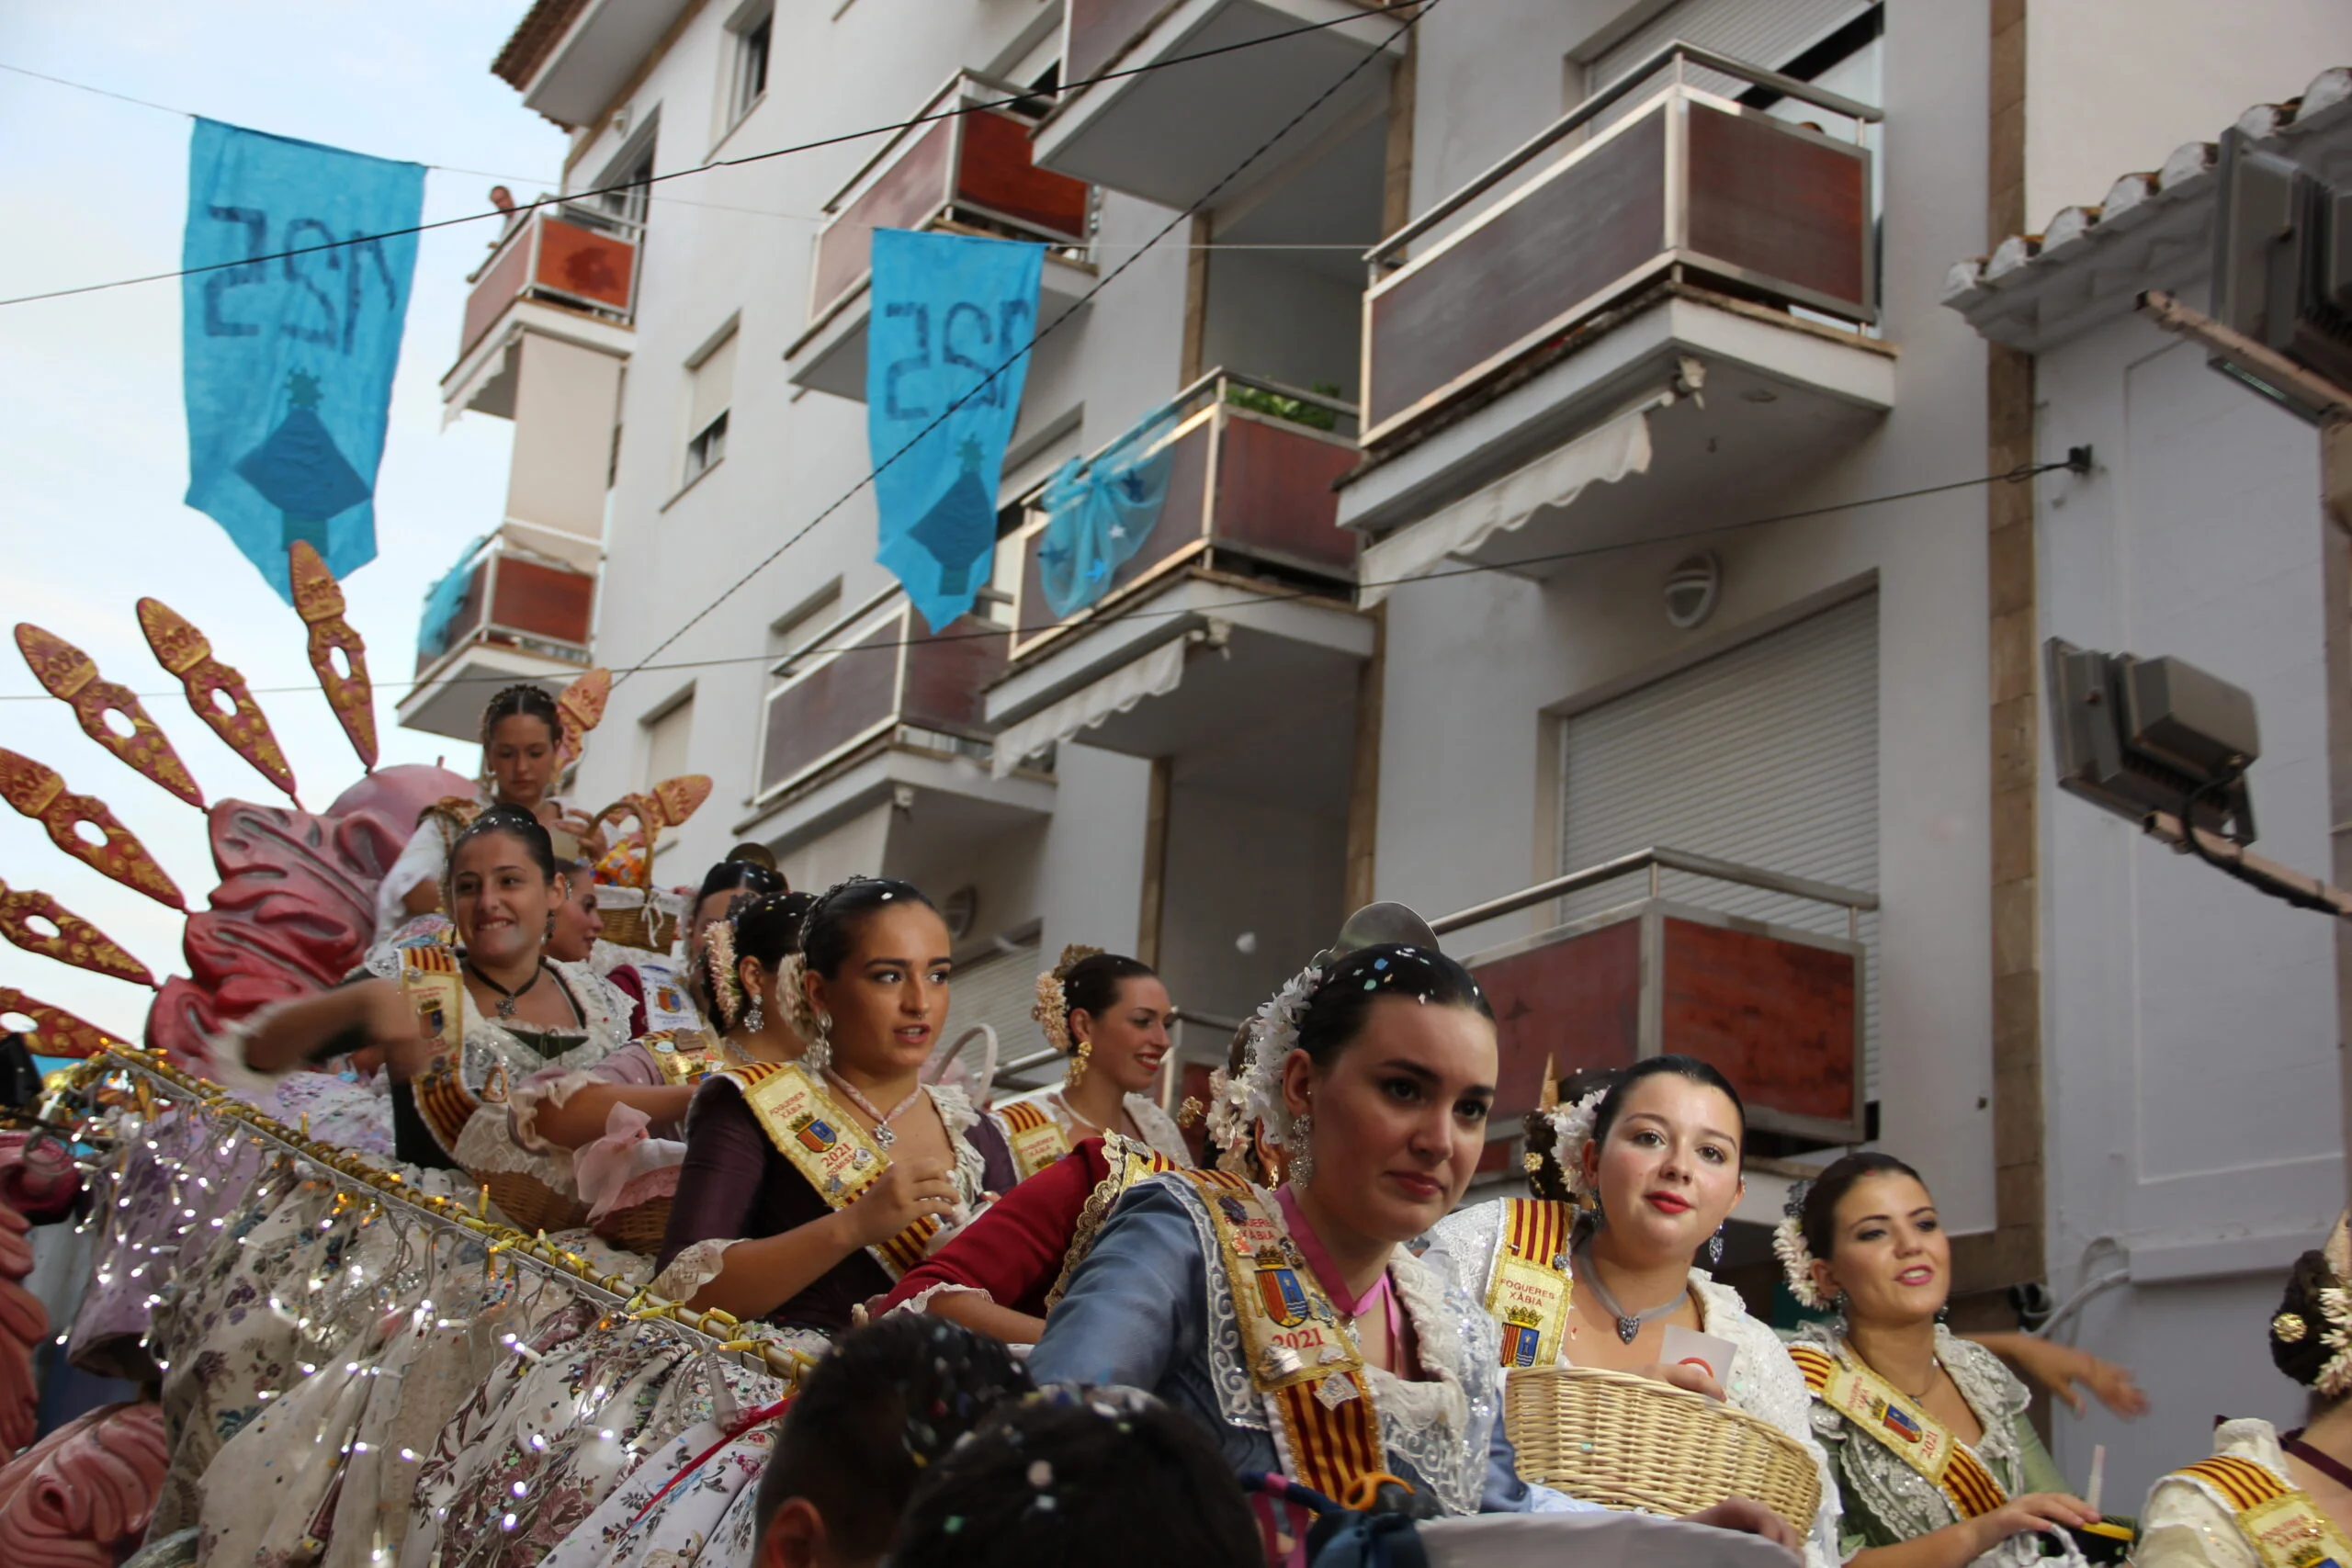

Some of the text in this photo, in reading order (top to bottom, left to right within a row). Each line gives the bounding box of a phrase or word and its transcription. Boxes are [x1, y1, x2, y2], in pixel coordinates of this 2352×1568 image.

[820, 1142, 853, 1168] 2021
[1500, 1278, 1555, 1300] FOGUERES
[1272, 1326, 1325, 1349] 2021
